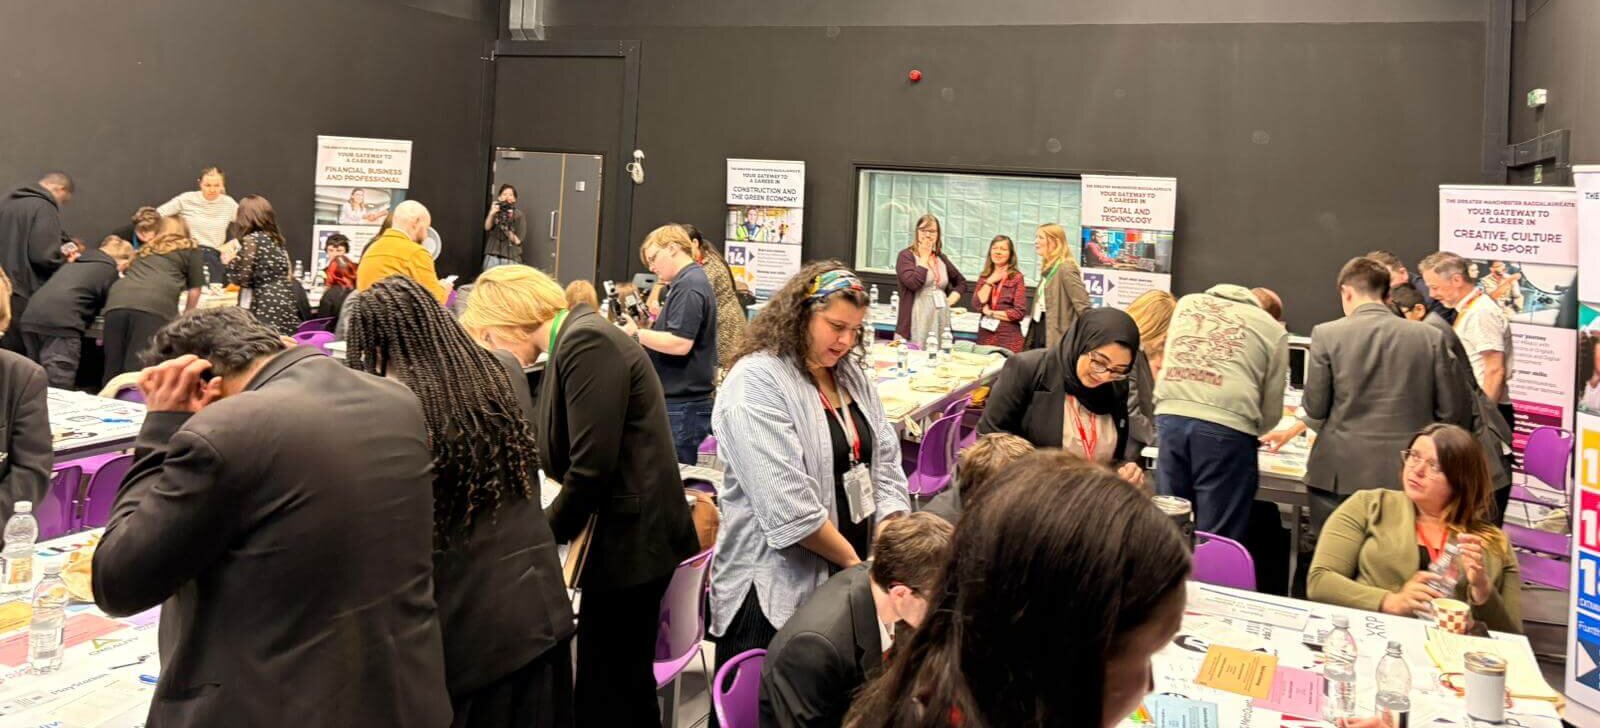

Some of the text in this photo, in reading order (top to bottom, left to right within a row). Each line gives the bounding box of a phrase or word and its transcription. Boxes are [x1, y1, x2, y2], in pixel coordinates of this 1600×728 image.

[368, 167, 402, 175] BUSINESS
[344, 174, 401, 183] PROFESSIONAL
[733, 186, 781, 194] CONSTRUCTION
[766, 195, 798, 203] ECONOMY
[1584, 191, 1600, 200] THE
[1103, 206, 1132, 214] DIGITAL
[1467, 208, 1550, 218] YOUR GATEWAY TO
[1101, 215, 1152, 224] TECHNOLOGY
[1488, 217, 1524, 225] CAREER
[1453, 229, 1563, 243] CREATIVE, CULTURE
[1474, 242, 1540, 255] AND SPORT
[729, 251, 745, 264] 14
[1581, 508, 1600, 547] 1
[1580, 558, 1600, 598] 1
